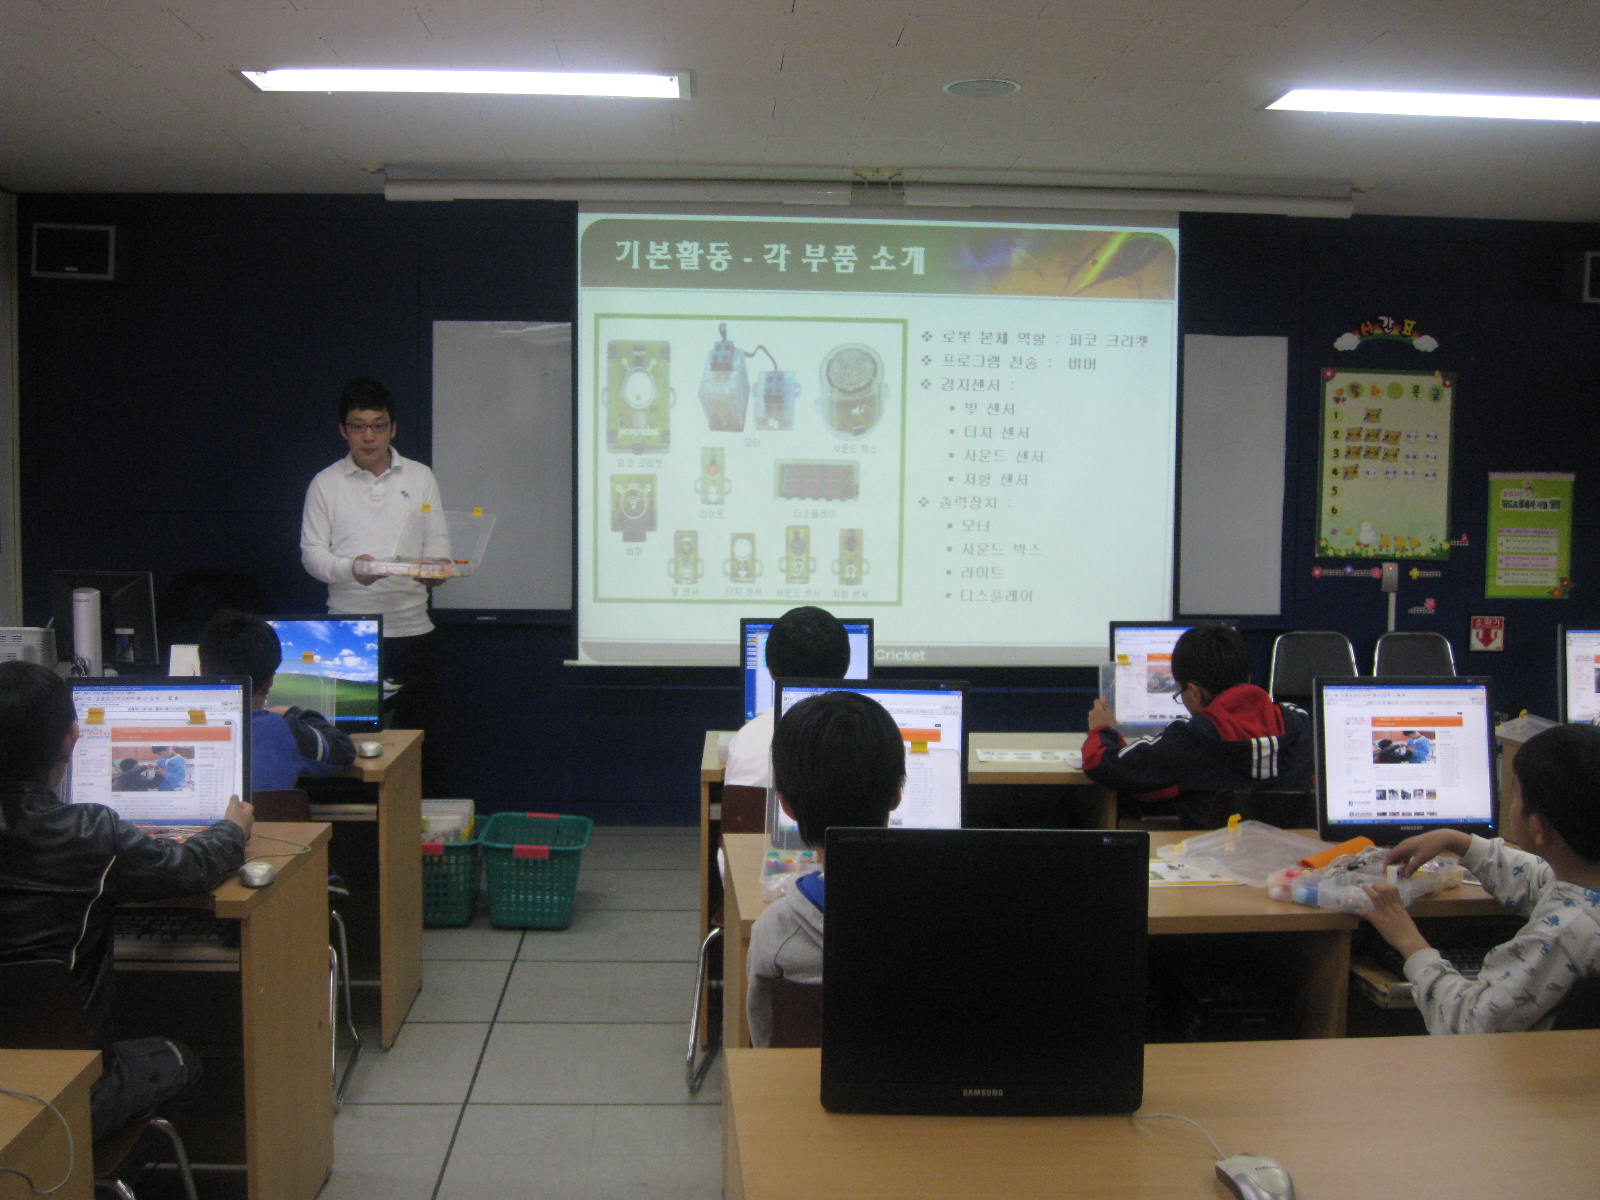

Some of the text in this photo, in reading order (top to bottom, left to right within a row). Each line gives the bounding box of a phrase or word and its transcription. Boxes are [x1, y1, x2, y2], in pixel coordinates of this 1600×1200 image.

[616, 240, 732, 271] 기본활동
[763, 243, 791, 272] 각
[801, 244, 859, 274] 부품
[870, 245, 925, 275] 소개
[943, 331, 970, 345] 로봇
[1069, 333, 1097, 347] 피코
[943, 354, 1000, 369] 프로그램
[1010, 355, 1038, 370] 전송
[941, 377, 1000, 392] 감지센서
[987, 403, 1015, 417] 센서
[964, 425, 1030, 440] 터치 센서
[1332, 430, 1340, 439] 2
[964, 449, 1044, 464] 사운드 센서
[1333, 449, 1340, 458] 3
[1000, 472, 1029, 487] 센서
[1332, 486, 1338, 495] 5
[1331, 506, 1338, 515] 6
[962, 519, 990, 533] 모터
[961, 543, 1005, 556] 사운드
[960, 566, 1004, 579] 라이트
[960, 589, 1033, 604] 디스플레이
[875, 649, 926, 661] Cricket
